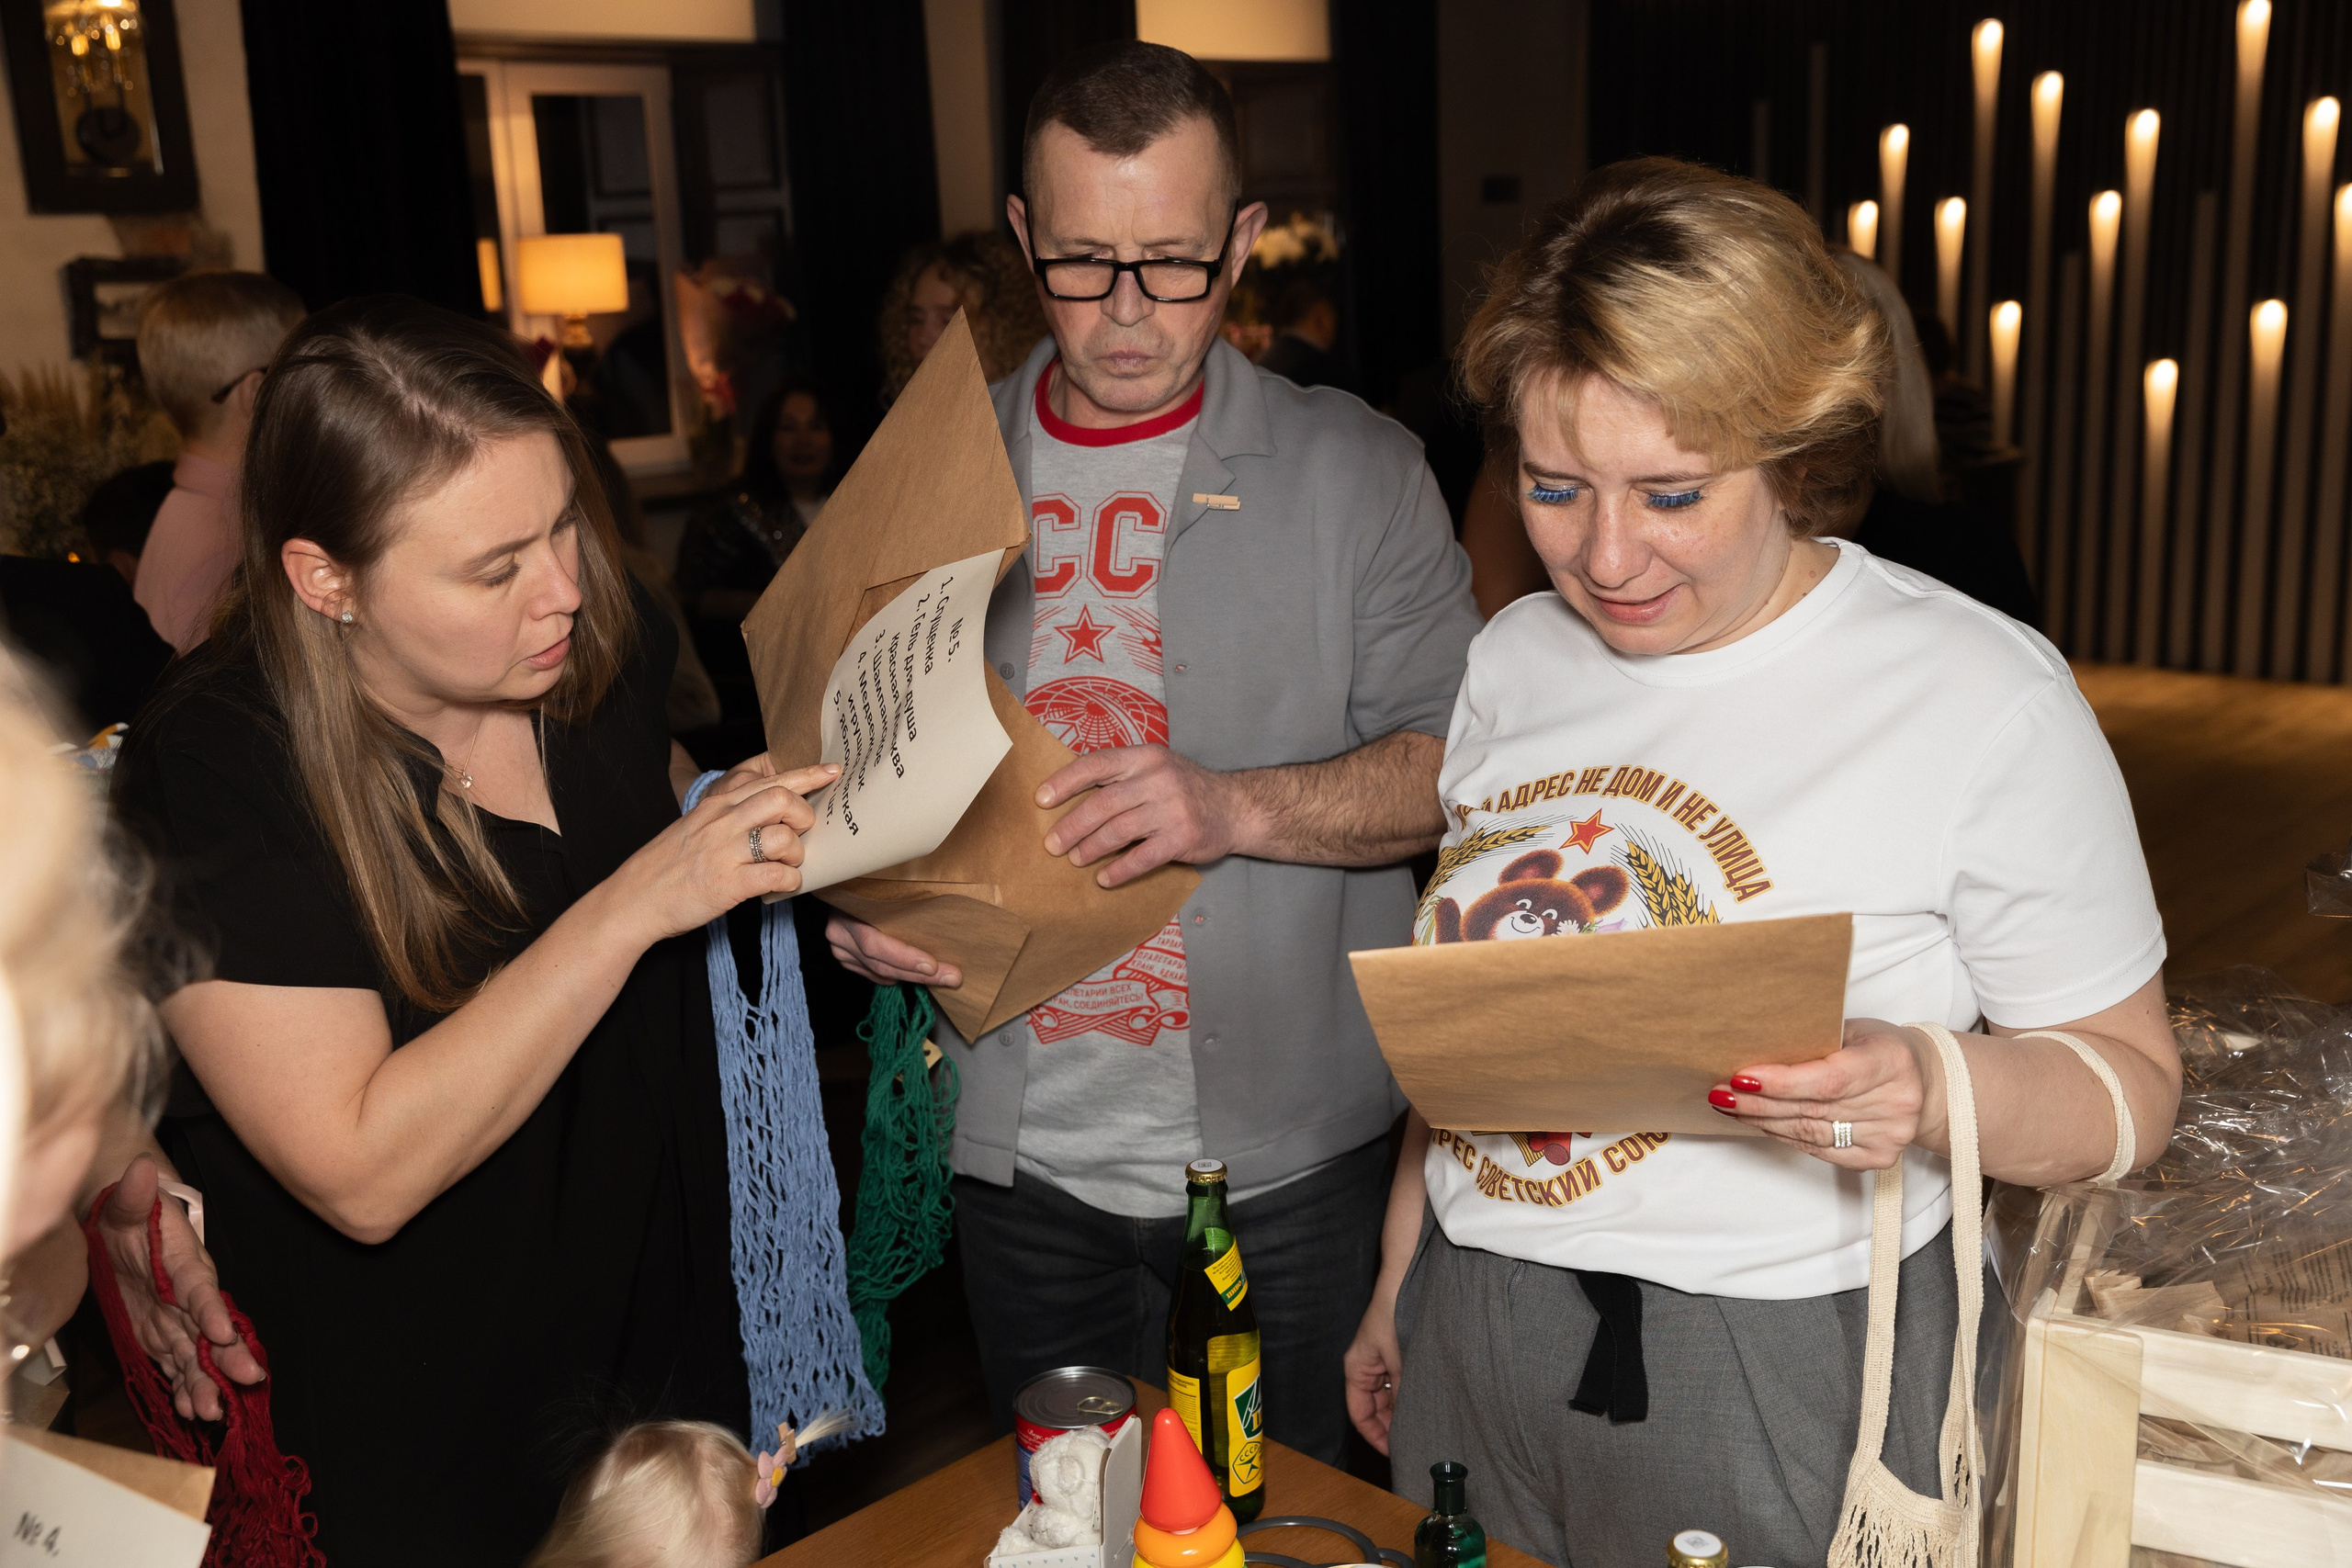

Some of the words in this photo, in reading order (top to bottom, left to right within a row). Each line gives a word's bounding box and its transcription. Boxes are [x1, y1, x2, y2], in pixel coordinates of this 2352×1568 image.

[916, 592, 931, 612] 2.
[940, 576, 954, 594] 1.
[874, 628, 886, 649] 3.
[907, 612, 926, 651] Гель
[924, 595, 950, 675] Сгущенка
[857, 650, 867, 670] 4.
[888, 632, 901, 705] красная
[903, 653, 915, 688] для
[833, 690, 842, 712] 5.
[873, 649, 888, 768] Шампанское
[903, 690, 917, 742] душа
[1495, 771, 1575, 814] АДРЕС
[1574, 765, 1613, 795] НЕ
[1601, 763, 1668, 808] ДОМ
[1656, 779, 1690, 813] И
[1672, 790, 1721, 833] НЕ
[1697, 816, 1774, 905] УЛИЦА
[1073, 993, 1144, 1010] СОЕДИНЯЙТЕСЬ!
[1110, 983, 1132, 995] ВСЕХ
[1433, 1129, 1477, 1172] РЕС
[1475, 1155, 1602, 1208] СОВЕТСКИЙ
[1238, 1444, 1258, 1462] СССР
